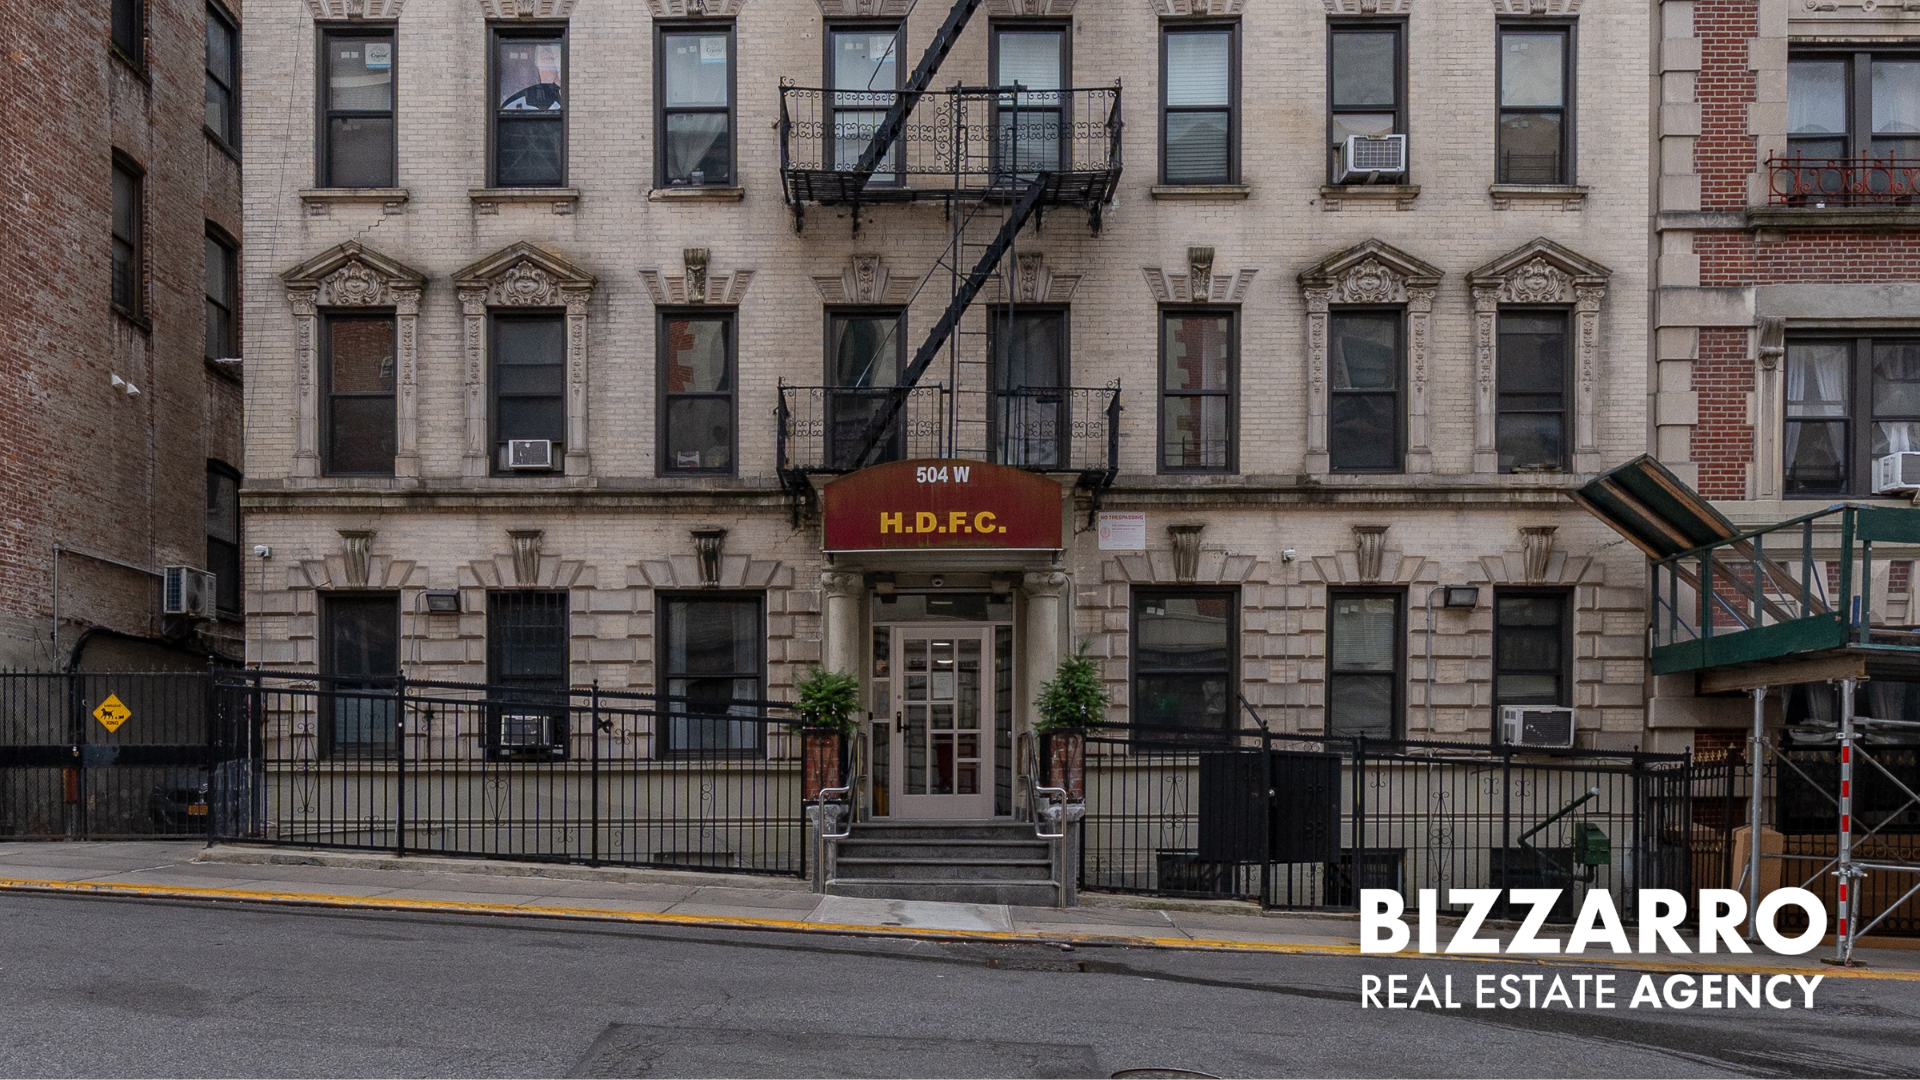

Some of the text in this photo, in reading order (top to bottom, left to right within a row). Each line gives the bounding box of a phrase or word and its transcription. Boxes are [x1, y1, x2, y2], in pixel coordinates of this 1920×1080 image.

[916, 466, 970, 483] 504 W
[880, 511, 1007, 534] H.D.F.C.
